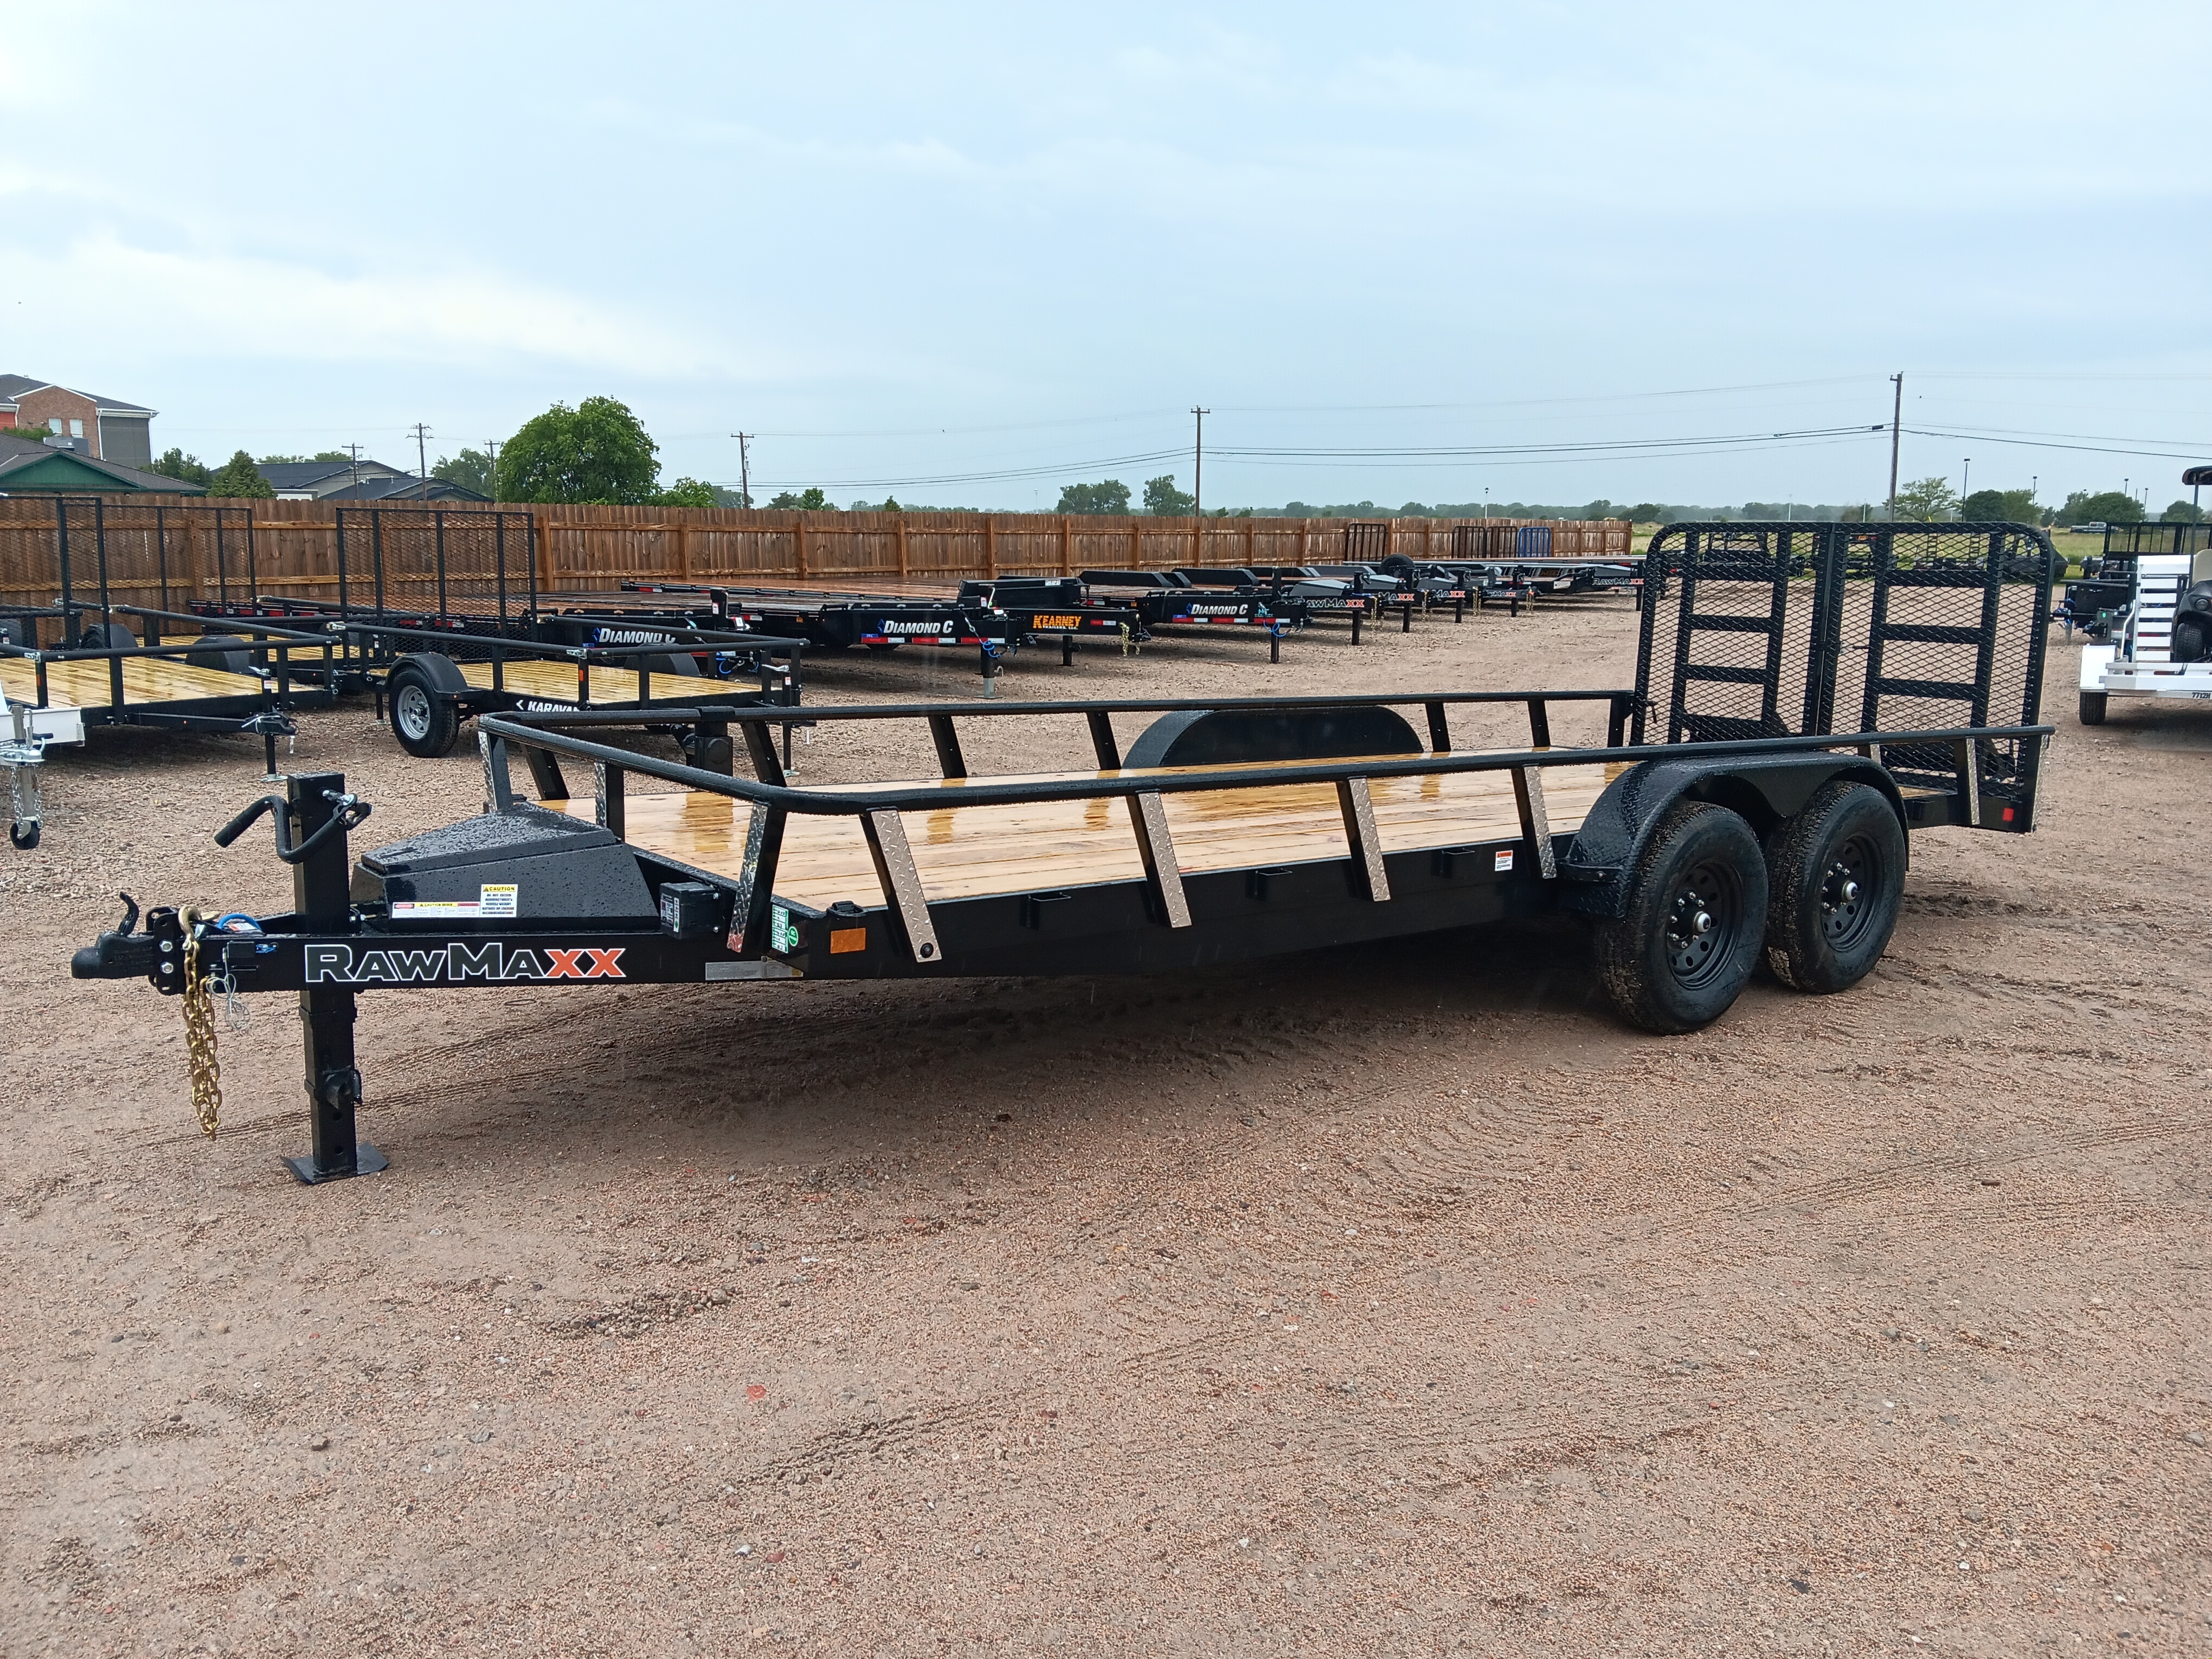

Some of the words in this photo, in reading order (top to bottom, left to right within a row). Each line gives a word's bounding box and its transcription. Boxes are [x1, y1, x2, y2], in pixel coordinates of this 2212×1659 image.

[1378, 591, 1414, 601] MAXX
[1432, 589, 1465, 598] MAXX
[1307, 598, 1365, 608] AWMAXX
[1191, 604, 1238, 615] DIAMOND
[1239, 604, 1248, 614] C
[884, 620, 941, 633] DIAMOND
[942, 620, 954, 633] C
[1033, 615, 1082, 628] KEARNEY
[599, 628, 663, 643] DIAMOND
[304, 943, 627, 982] RAWMAXX
